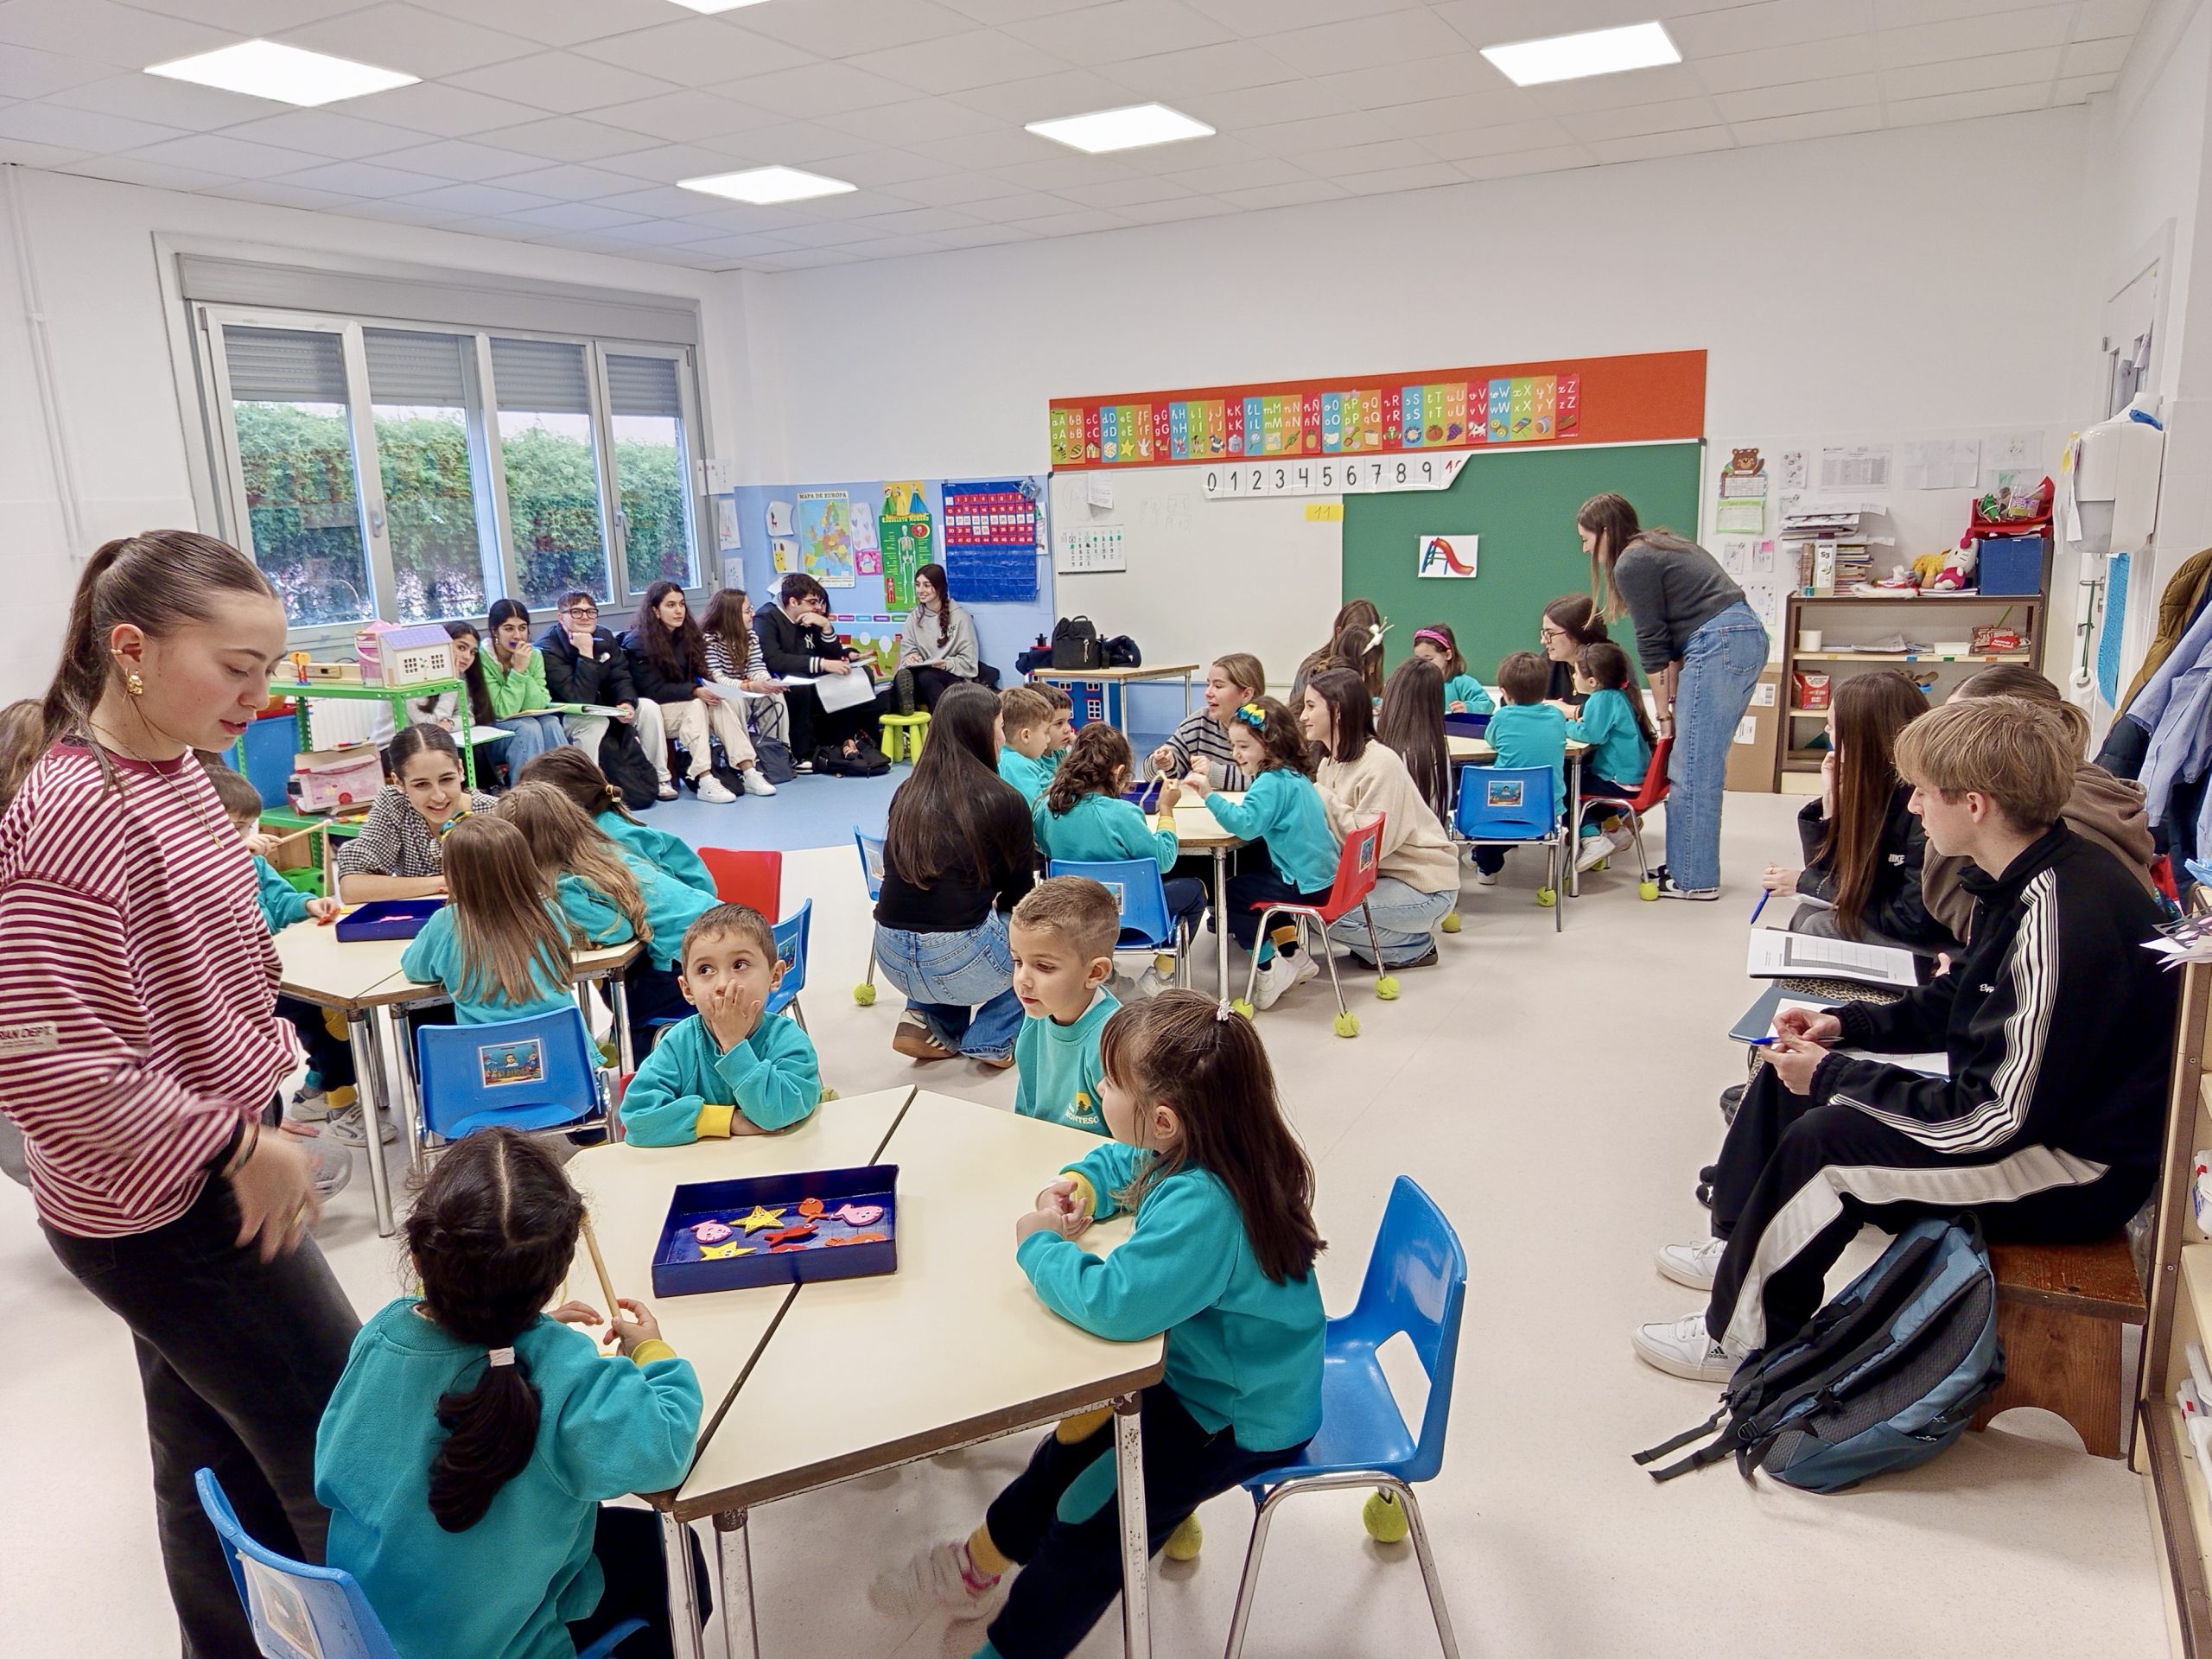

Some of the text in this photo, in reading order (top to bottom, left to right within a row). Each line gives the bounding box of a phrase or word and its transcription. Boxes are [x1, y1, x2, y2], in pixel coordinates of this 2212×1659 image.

[1208, 473, 1217, 491] 0
[1230, 472, 1236, 491] 1
[1253, 470, 1262, 490] 2
[1275, 469, 1285, 488] 3
[1300, 467, 1308, 487] 4
[1323, 467, 1332, 486] 5
[1347, 466, 1357, 485] 6
[1371, 464, 1381, 484] 7
[1396, 463, 1406, 483] 8
[1422, 462, 1432, 482] 9
